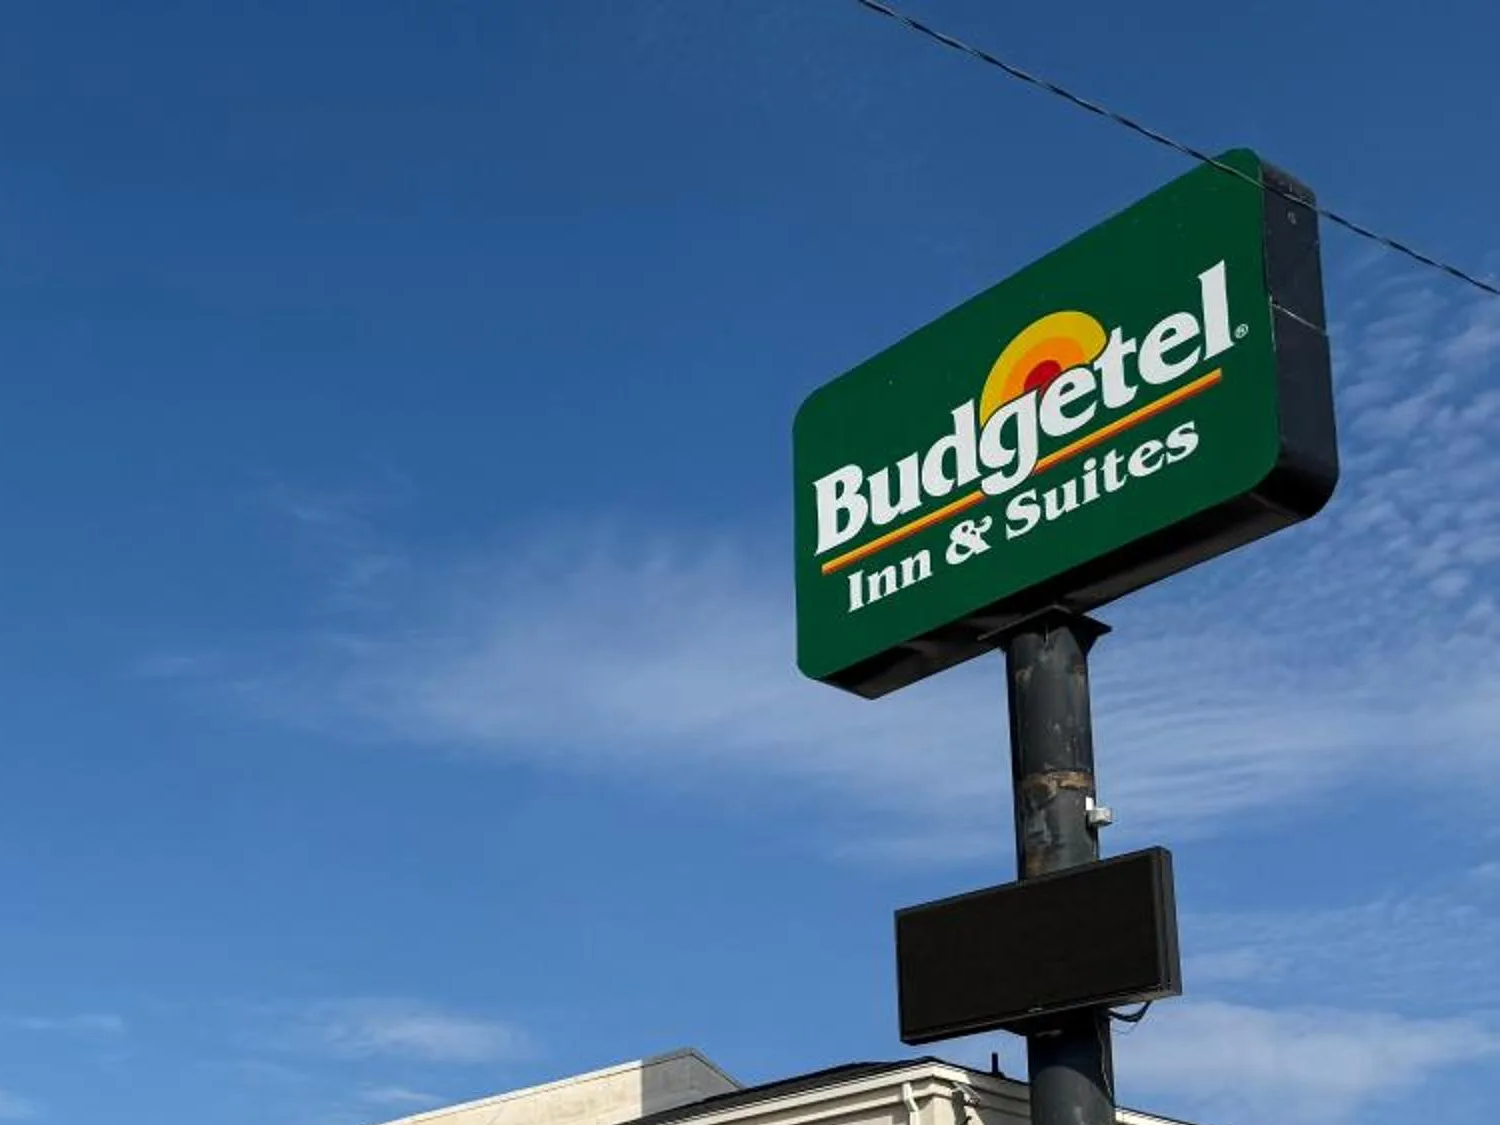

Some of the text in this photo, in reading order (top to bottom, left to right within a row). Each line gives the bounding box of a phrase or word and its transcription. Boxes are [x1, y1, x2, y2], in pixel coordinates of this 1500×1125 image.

[811, 260, 1235, 555] Budgetel
[847, 420, 1200, 612] Inn & Suites
